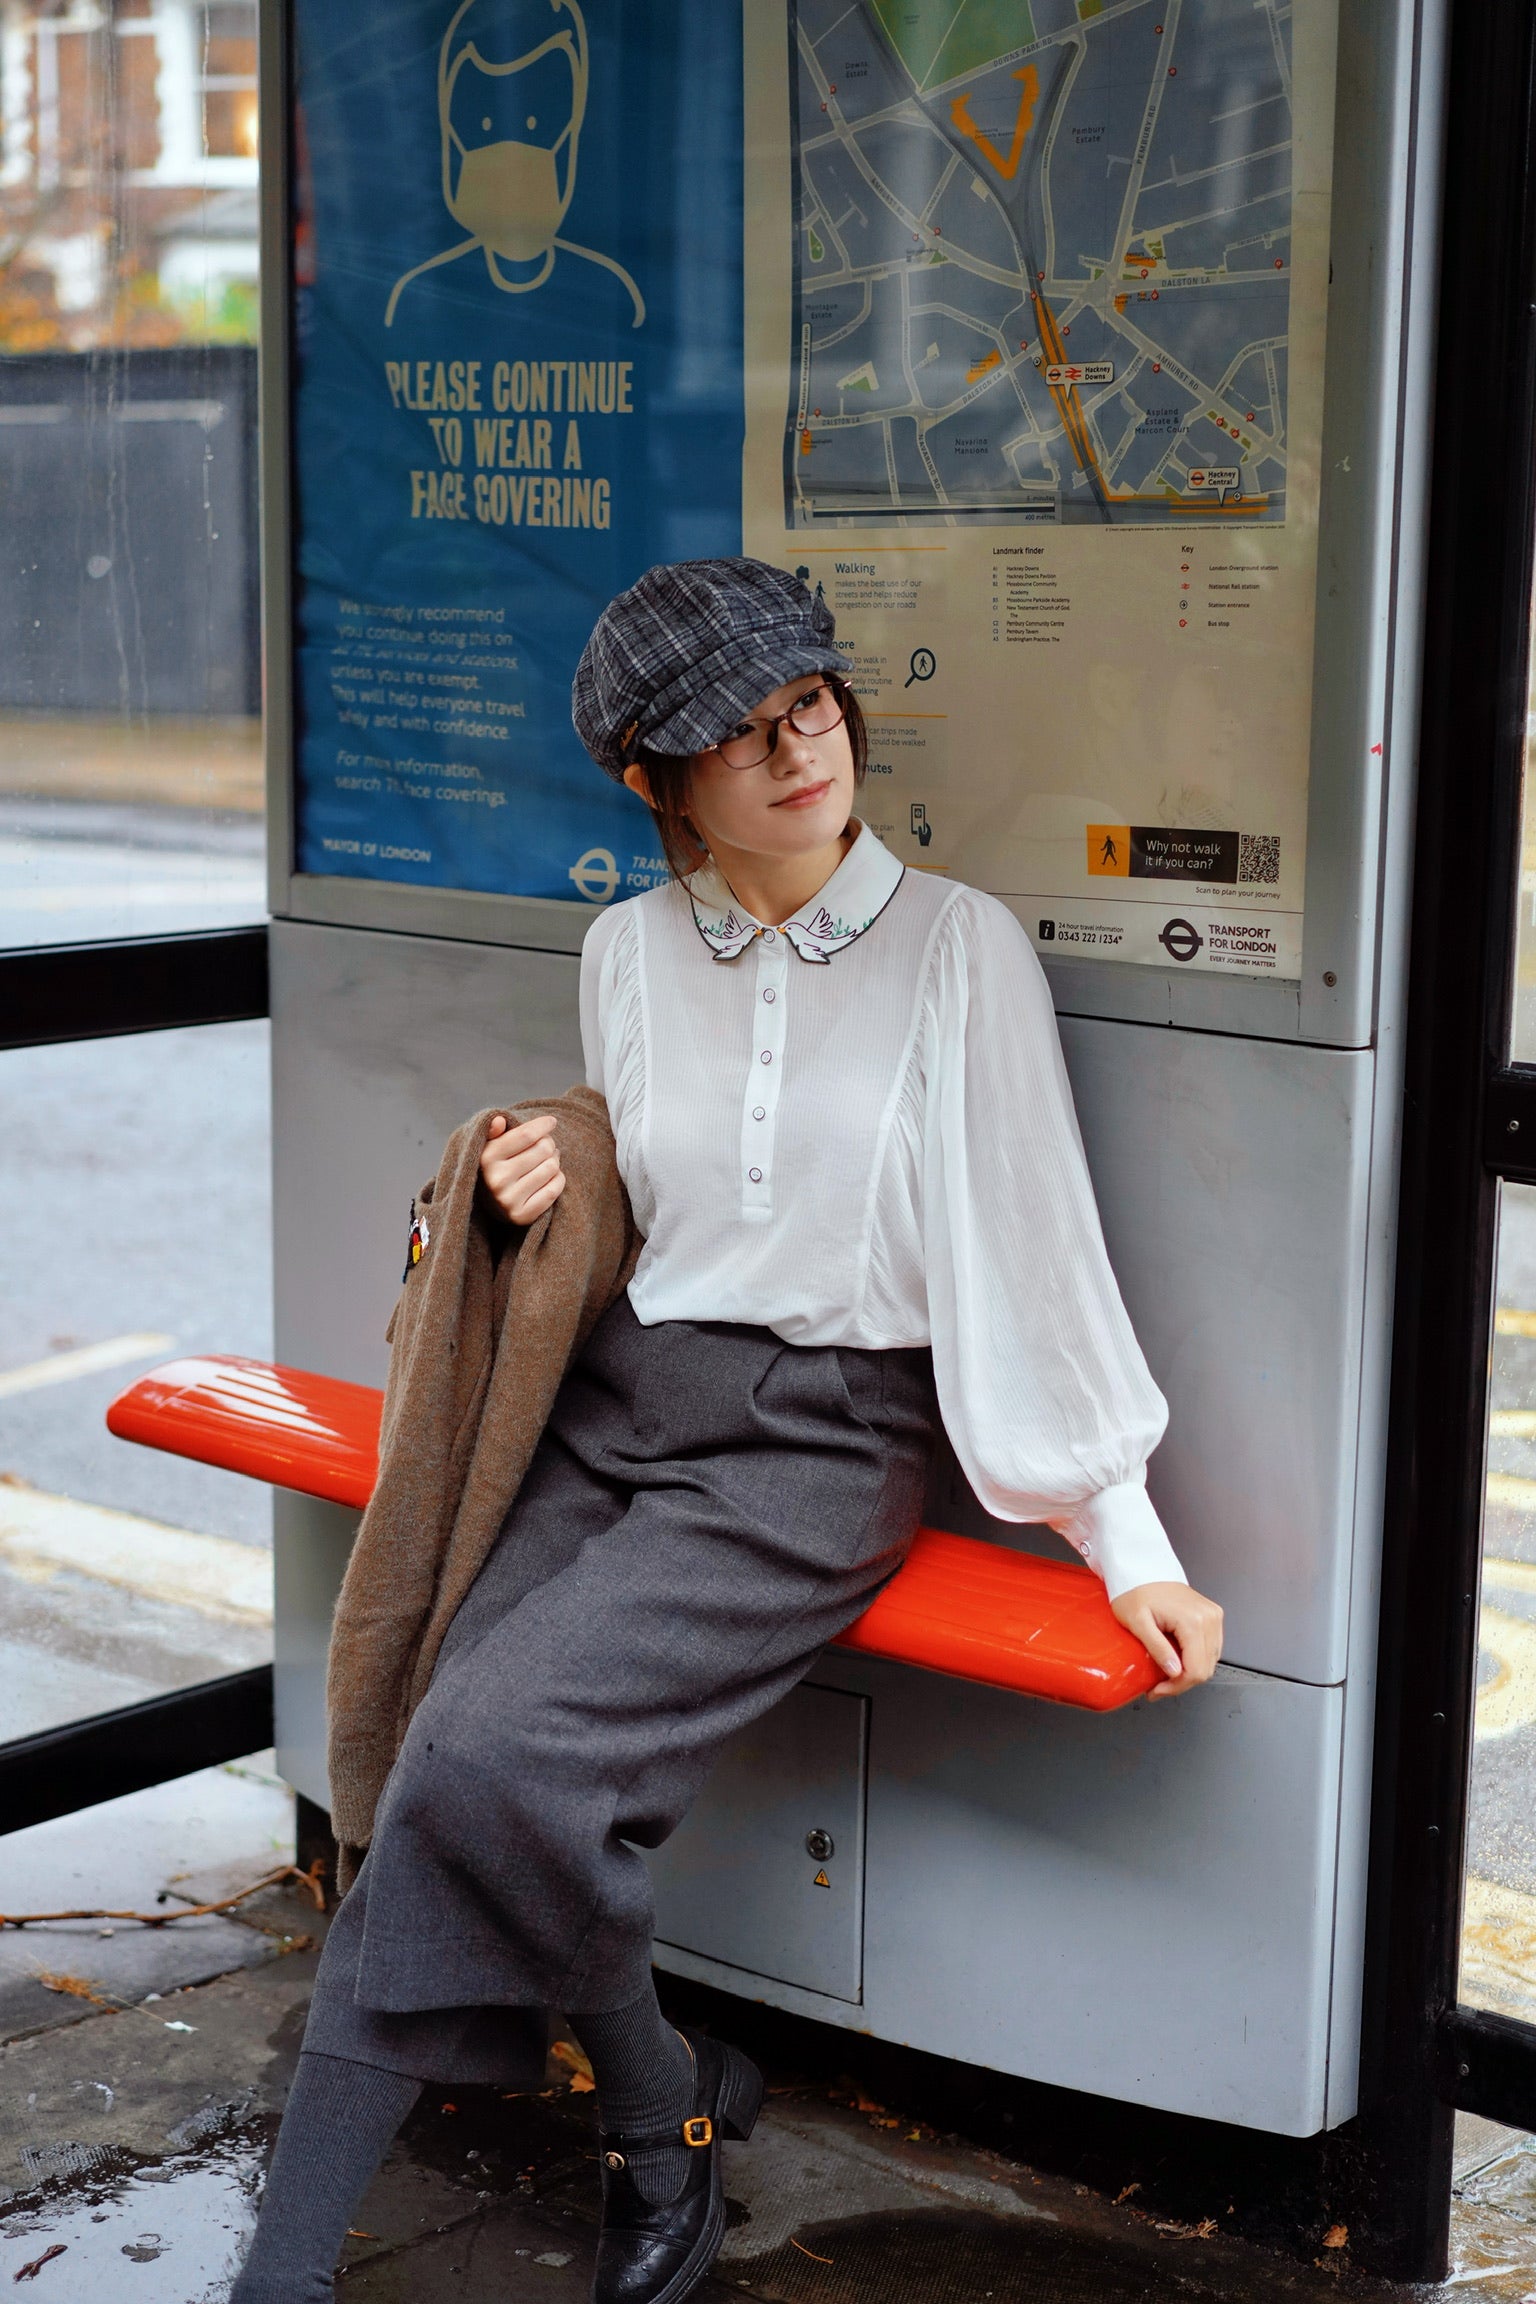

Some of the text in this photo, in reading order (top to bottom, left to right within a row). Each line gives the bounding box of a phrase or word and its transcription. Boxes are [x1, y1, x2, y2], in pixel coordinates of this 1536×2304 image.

[993, 51, 1020, 67] DOWNS
[1022, 43, 1040, 55] PARK
[845, 62, 868, 70] Downs
[846, 70, 868, 78] Estate
[1072, 126, 1105, 136] Pembury
[1076, 135, 1101, 144] Estate
[1136, 121, 1152, 165] PEMBURY
[1161, 277, 1211, 287] DALSTON LA
[811, 311, 832, 319] Estate
[1085, 366, 1111, 375] Hackney
[1155, 353, 1189, 383] AMHURST
[1187, 378, 1199, 391] RD
[1085, 373, 1106, 381] Downs
[384, 361, 633, 413] PLEASE CONTINUE
[962, 380, 993, 405] DALSTON
[1146, 409, 1179, 417] Aspland
[821, 417, 851, 426] DALSTON
[1135, 426, 1190, 435] Marcon Court
[428, 418, 582, 470] TO WEAR A
[955, 438, 988, 446] Navarino
[918, 433, 936, 476] NAVARINO
[955, 447, 989, 455] Mansions
[1208, 471, 1236, 480] Hackney
[410, 471, 611, 530] FACE COVERING
[992, 547, 1045, 555] Landmark finder
[1181, 545, 1194, 554] Key
[835, 563, 876, 576] Walking
[835, 579, 923, 588] makes the best use of our
[835, 591, 918, 600] streets and helps reduce
[338, 599, 505, 622] We recommend
[835, 601, 872, 611] congestion
[896, 601, 917, 609] roads
[337, 625, 513, 649] you continue doing this on
[854, 655, 887, 664] to walk in
[856, 667, 881, 676] making
[330, 665, 482, 691] unless you are exempt.
[852, 676, 893, 686] daily routine
[852, 687, 879, 696] walking
[359, 688, 526, 718] will help everyone travel
[373, 713, 511, 740] and with confidence.
[881, 728, 898, 736] trips
[898, 728, 918, 736] made
[871, 738, 891, 746] could
[901, 739, 926, 747] walked
[336, 750, 485, 781] For information,
[335, 774, 382, 791] search
[435, 786, 508, 809] coverings.
[879, 824, 895, 832] plan
[322, 838, 432, 863] MAYOR OF LONDON
[1146, 839, 1222, 856] Why not walk
[1145, 855, 1214, 870] it if you can?
[626, 873, 651, 888] FOR
[1195, 886, 1281, 900] Scan to plan your journey
[1066, 922, 1080, 930] hour
[1080, 923, 1095, 931] travel
[1095, 925, 1124, 933] information
[1208, 924, 1271, 939] TRANSPORT
[1058, 931, 1080, 942] 0343
[1081, 932, 1097, 943] 222
[1209, 937, 1277, 953] FOR LONDON
[1209, 955, 1276, 968] EVERY JOURNEY MATTERS
